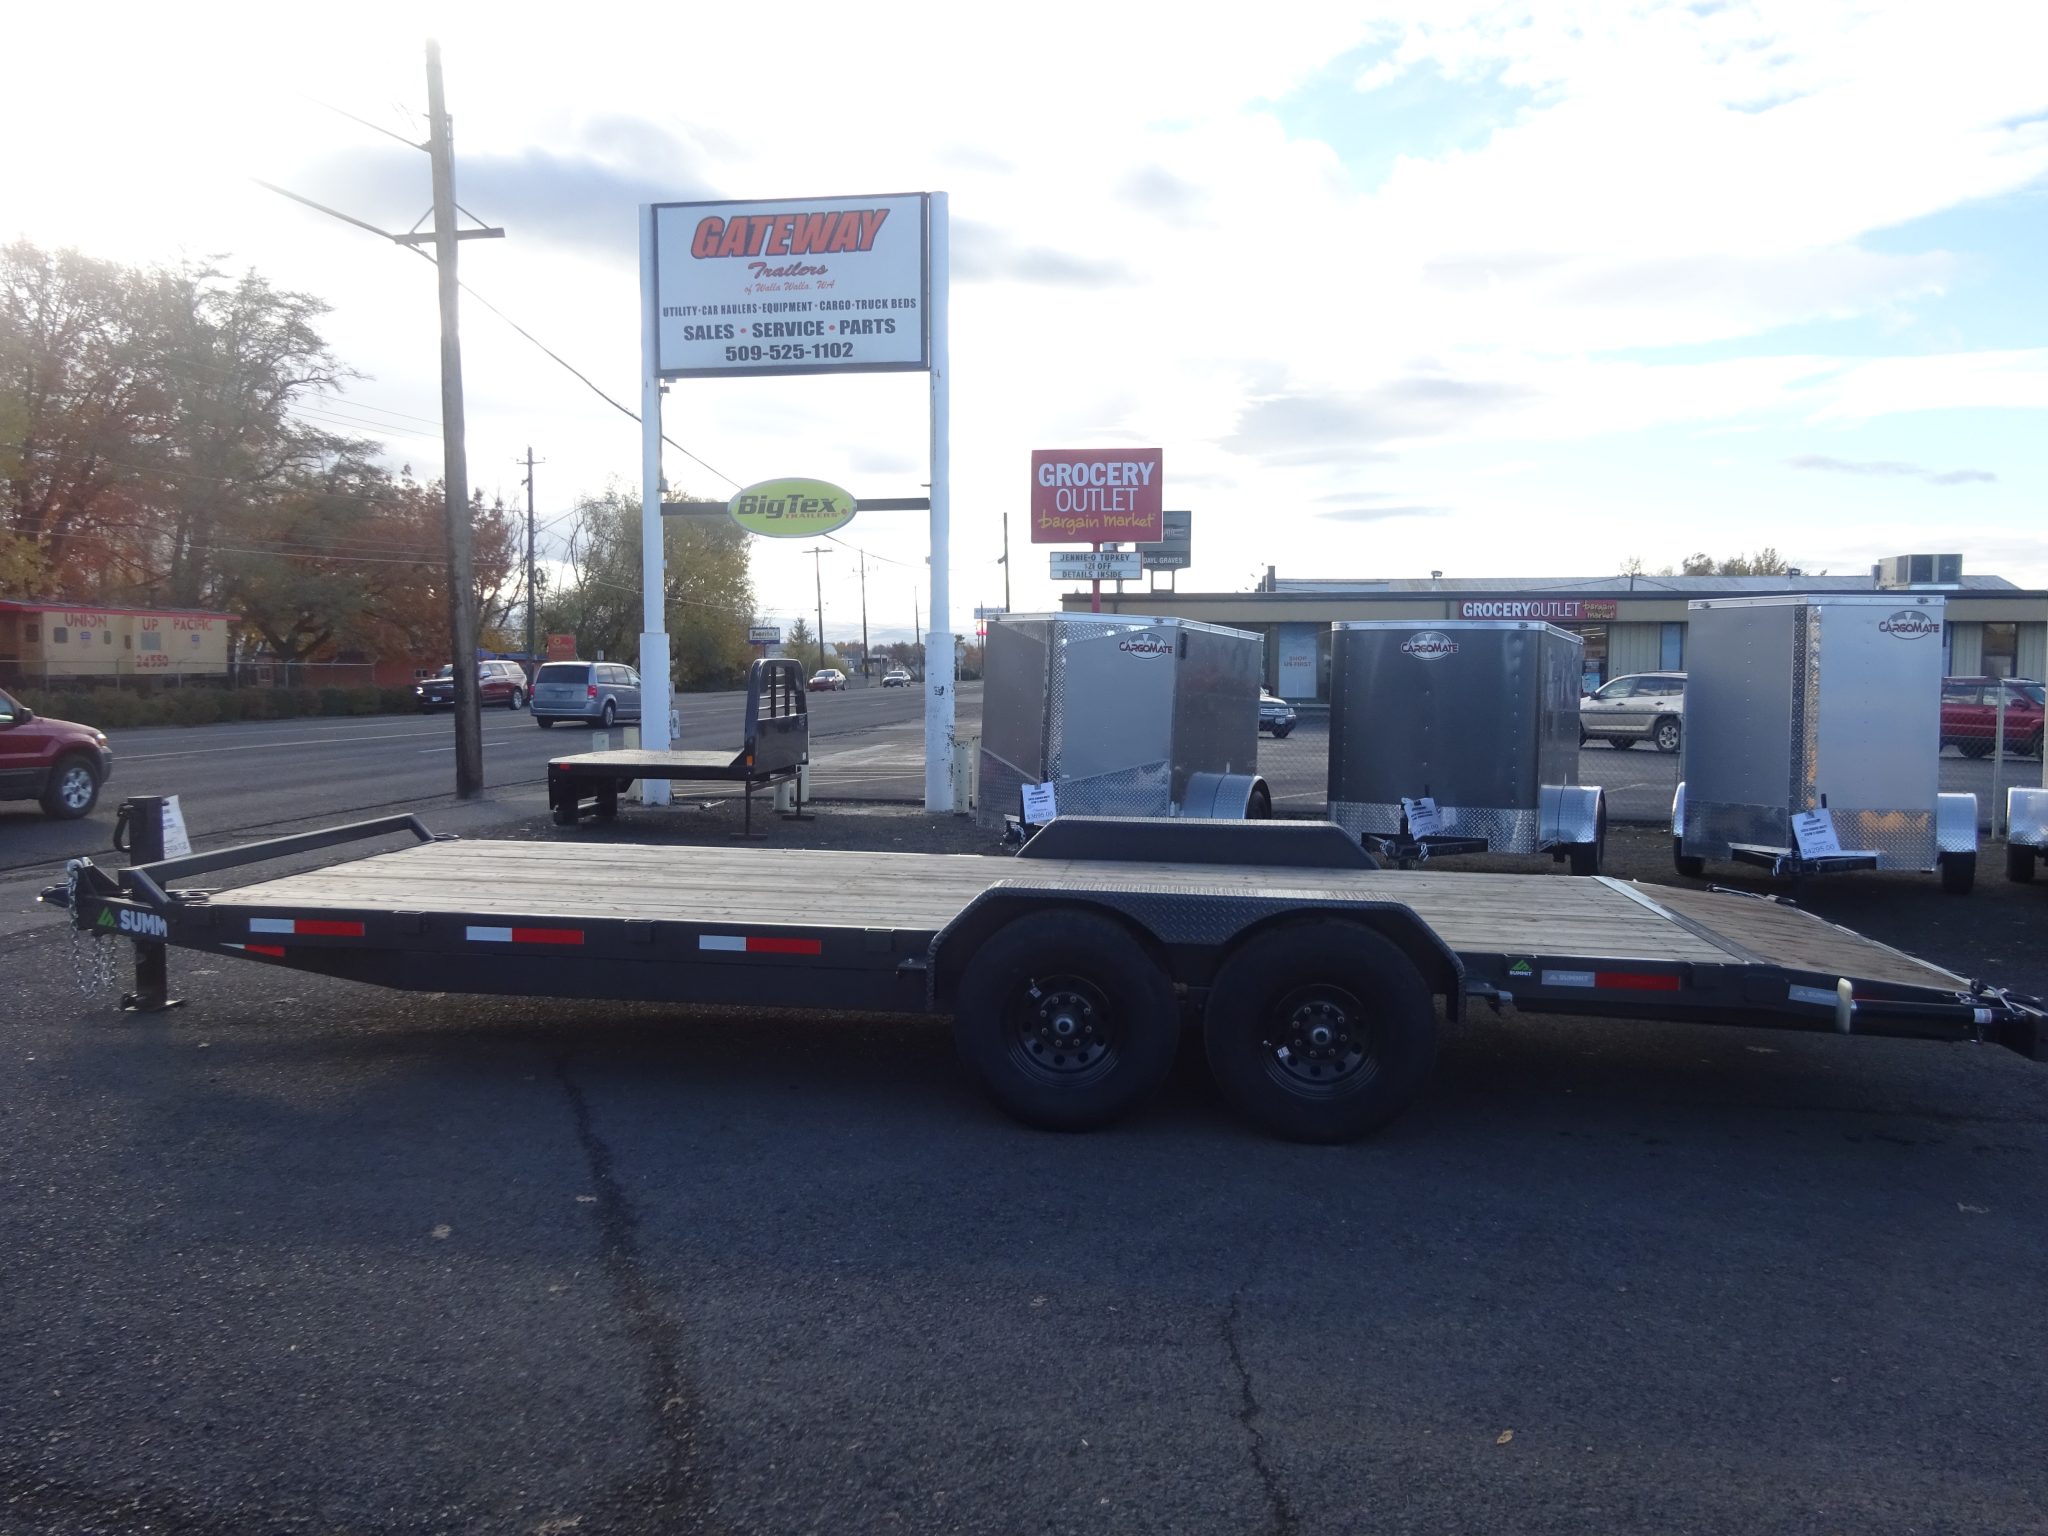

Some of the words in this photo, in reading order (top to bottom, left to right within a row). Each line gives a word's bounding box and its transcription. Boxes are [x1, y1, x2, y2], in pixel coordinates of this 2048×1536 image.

[691, 209, 890, 259] GATEWAY
[748, 262, 828, 279] Trailers
[744, 284, 752, 295] of
[755, 283, 780, 292] Walla
[816, 280, 835, 289] WA
[663, 306, 697, 317] UTILITY
[702, 304, 718, 316] CAR
[720, 303, 757, 315] HAULERS
[762, 301, 812, 314] EQUIPMENT
[820, 299, 851, 311] CARGO
[856, 298, 888, 310] TRUCK
[891, 298, 917, 309] BEDS
[683, 323, 735, 341] SALES
[752, 320, 824, 338] SERVICE
[839, 318, 896, 335] PARTS
[725, 342, 853, 362] 509-525-1102
[1038, 462, 1155, 487] GROCERY
[737, 494, 838, 519] BigTex
[1056, 487, 1138, 512] OUTLET
[1038, 510, 1099, 535] bargain
[1104, 512, 1154, 528] market
[64, 613, 107, 628] UNION
[142, 618, 159, 631] UP
